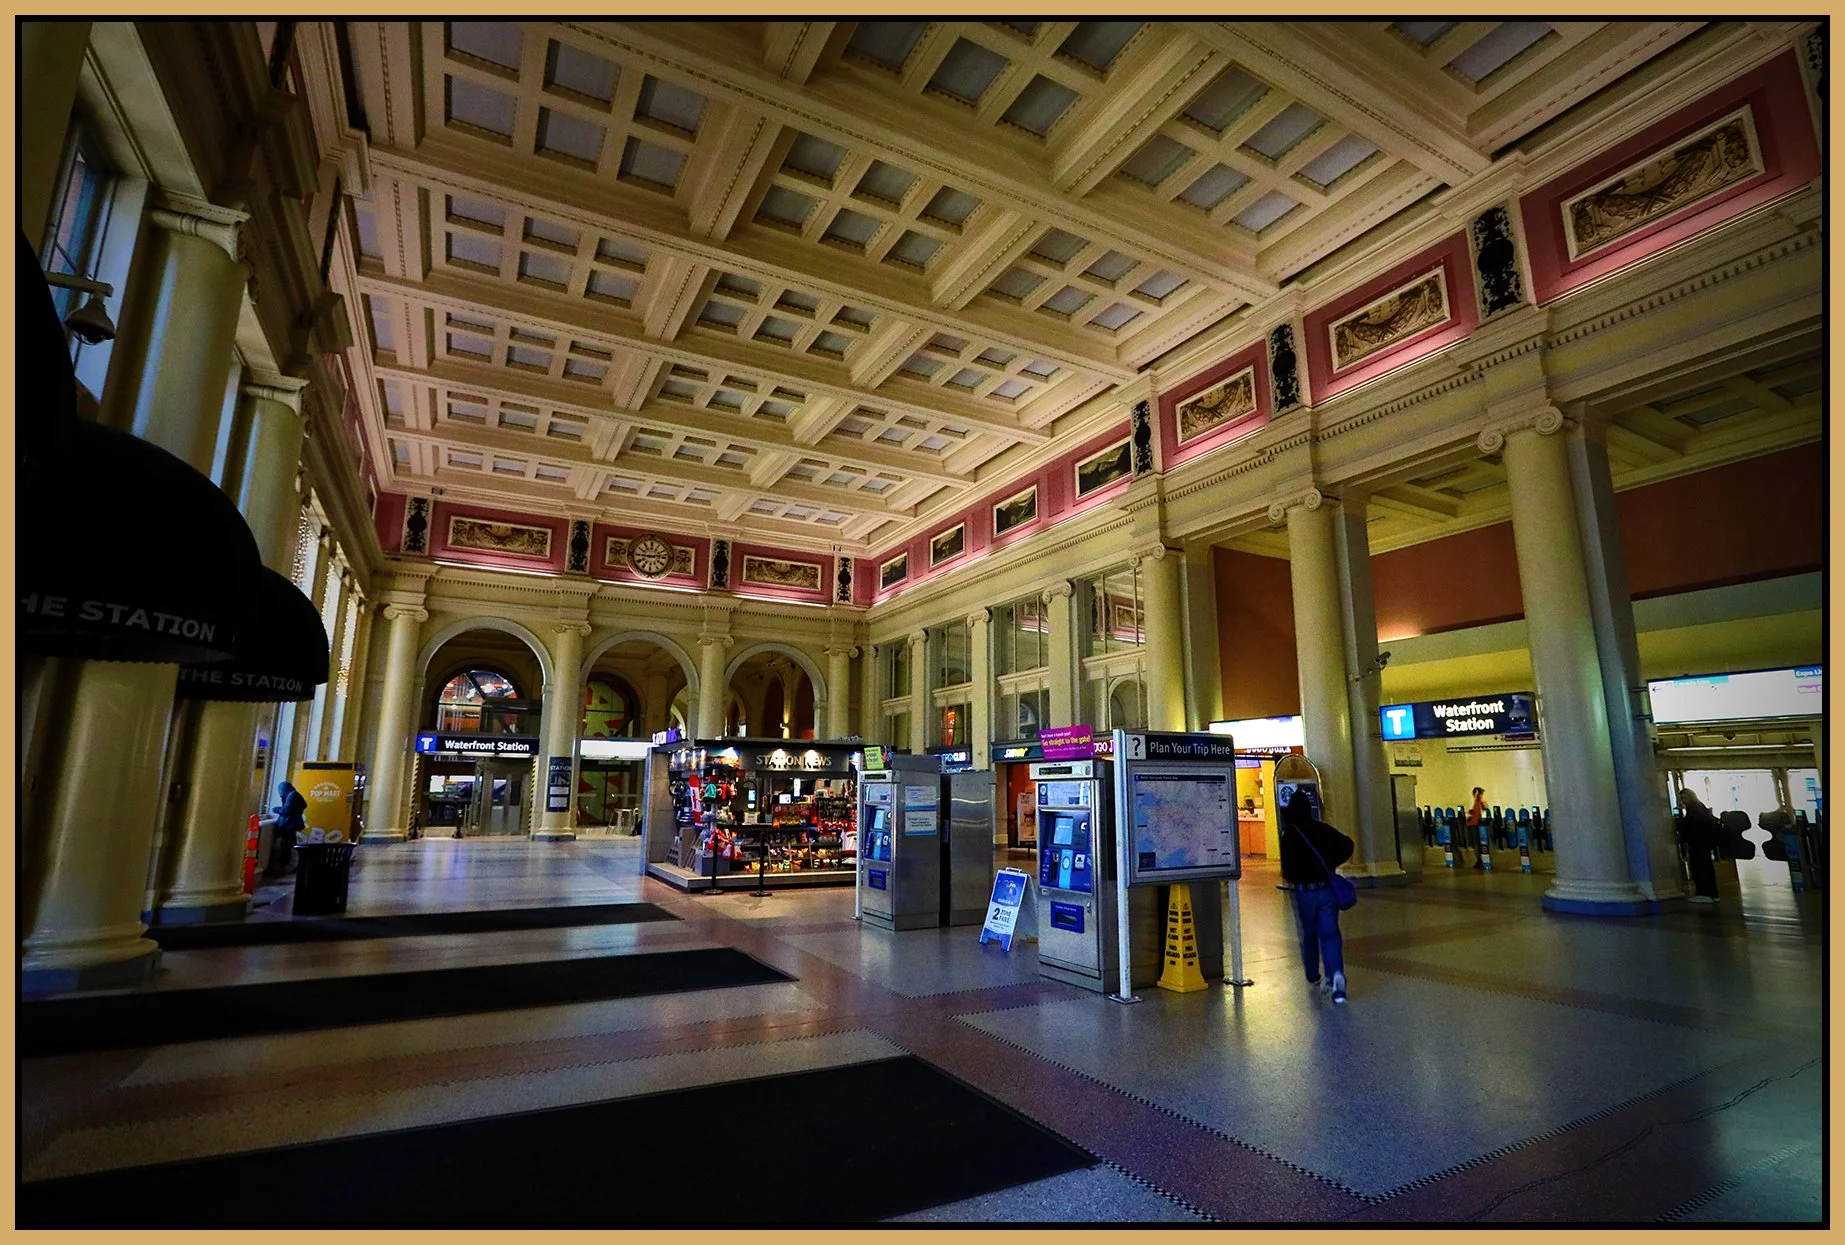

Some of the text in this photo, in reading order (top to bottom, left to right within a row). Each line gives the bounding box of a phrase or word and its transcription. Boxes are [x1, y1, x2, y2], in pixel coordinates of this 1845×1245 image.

[79, 600, 217, 643] STATION
[230, 672, 304, 693] STATION
[1432, 700, 1505, 719] Waterfront
[1445, 716, 1494, 733] Station
[444, 739, 495, 751] Waterfront
[497, 741, 530, 752] Station
[1048, 738, 1065, 747] straight
[1150, 741, 1170, 754] Plan
[1172, 742, 1191, 754] Your
[1192, 743, 1208, 757] Trip
[1210, 743, 1231, 755] Here
[992, 907, 1001, 921] 2
